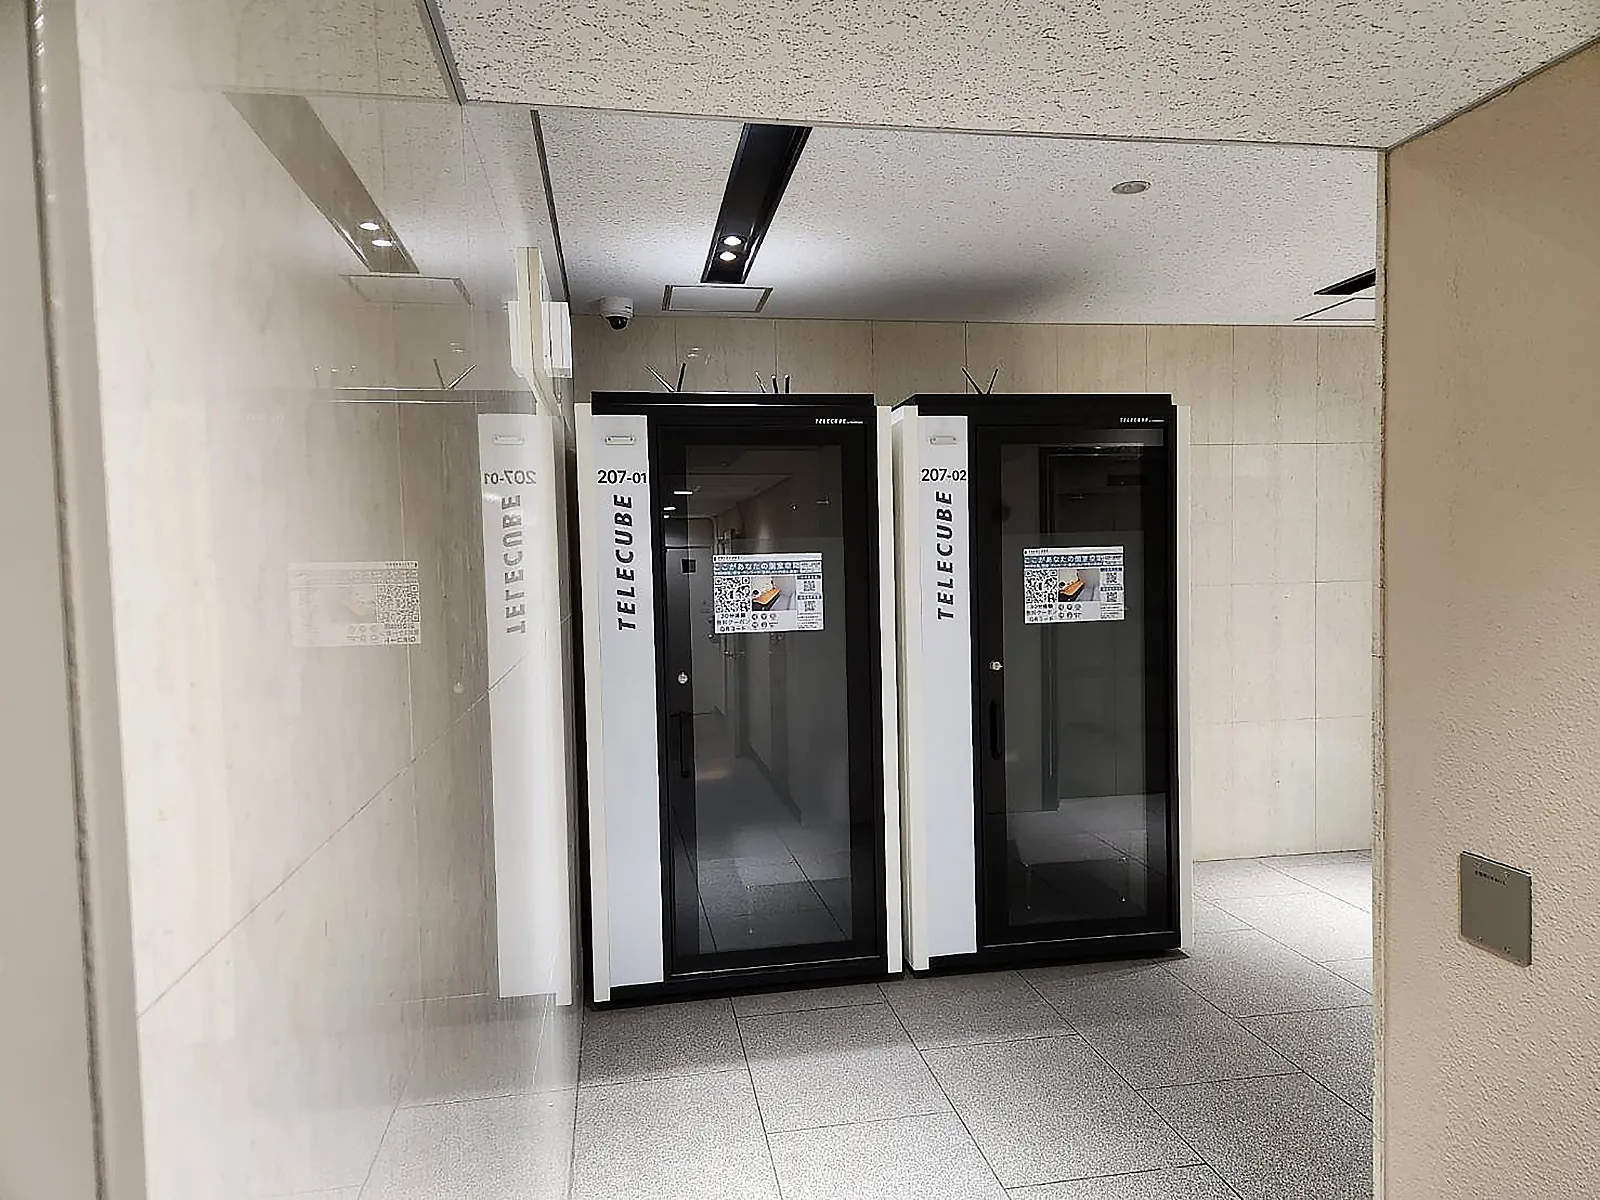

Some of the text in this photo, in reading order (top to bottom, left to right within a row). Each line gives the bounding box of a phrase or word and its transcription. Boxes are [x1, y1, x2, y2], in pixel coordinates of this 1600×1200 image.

[597, 470, 648, 485] 207-01
[921, 468, 967, 483] 207-02
[613, 494, 637, 632] TELECUBE
[935, 491, 955, 621] TELECUBE
